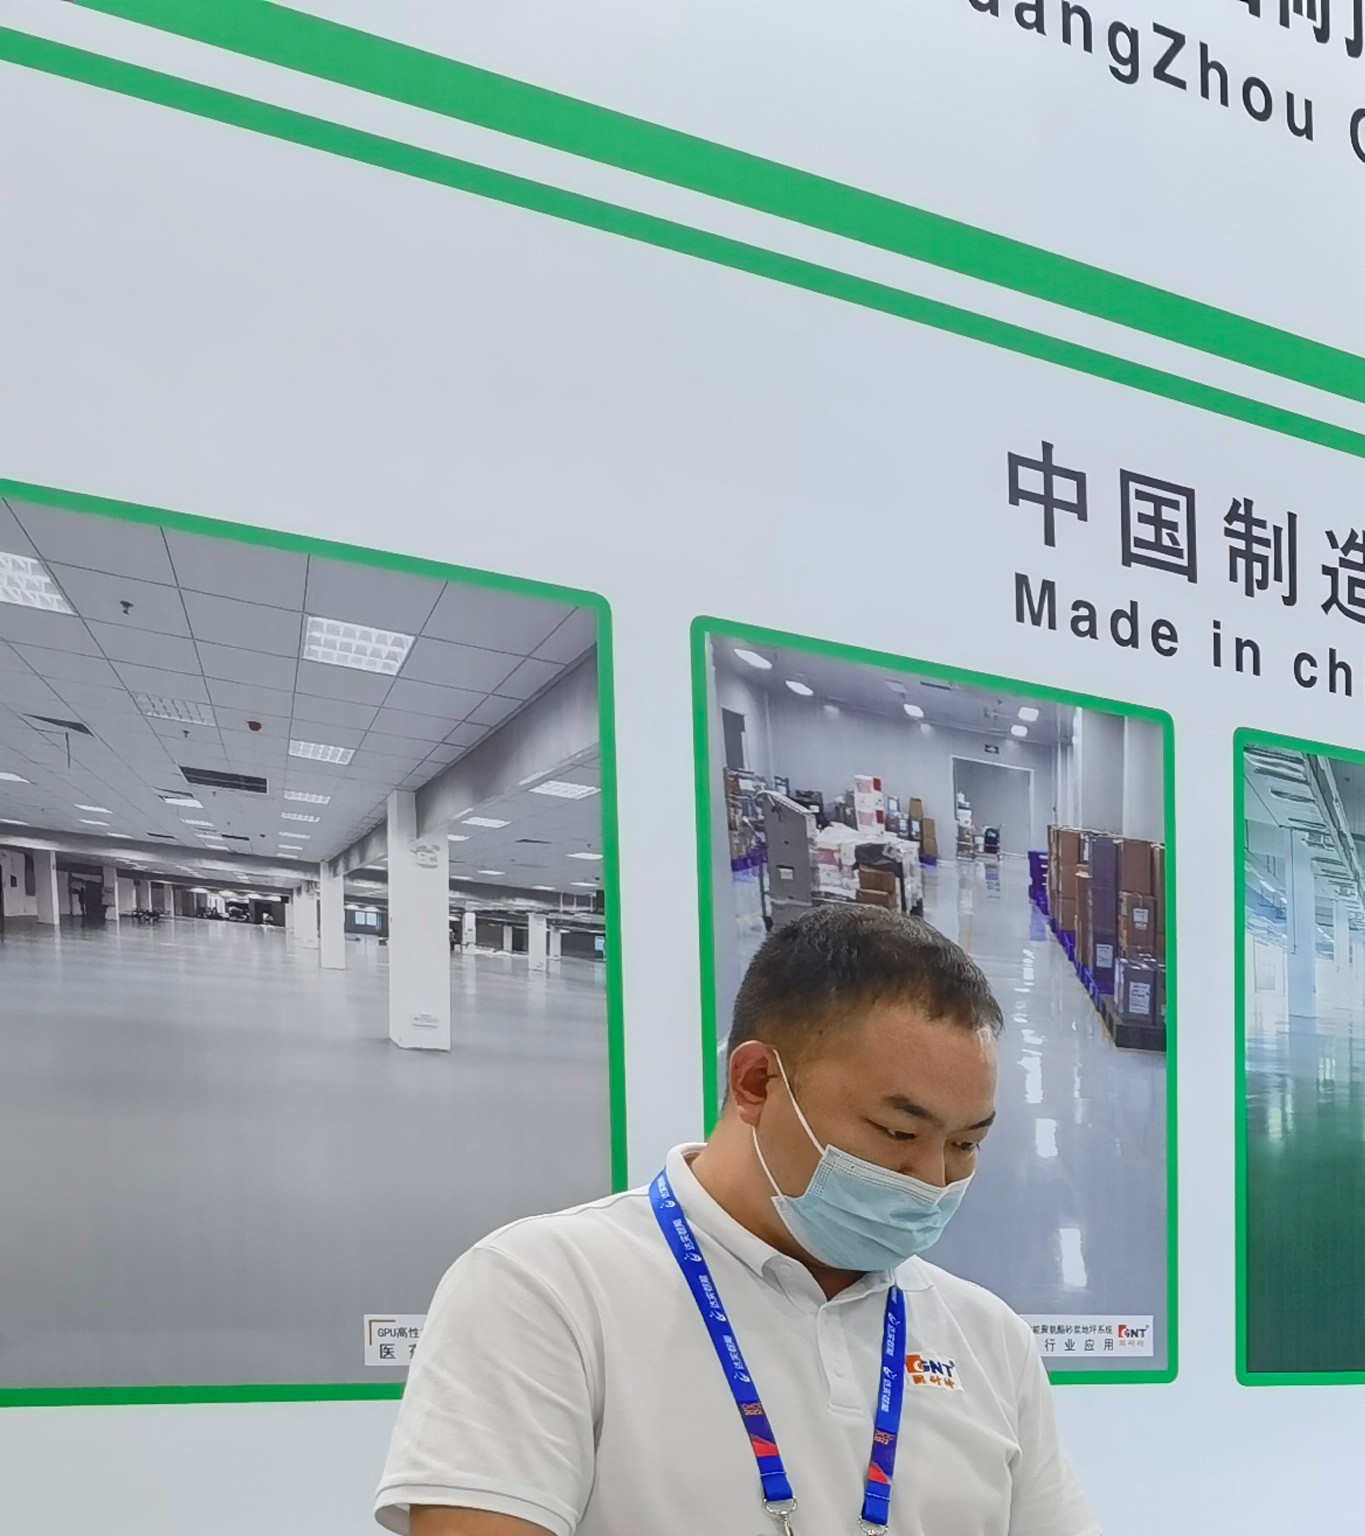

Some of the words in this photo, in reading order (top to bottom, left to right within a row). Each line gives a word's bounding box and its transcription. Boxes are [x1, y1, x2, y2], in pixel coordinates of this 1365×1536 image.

[968, 0, 1313, 141] angZhou
[1014, 572, 1180, 657] Made
[1212, 620, 1262, 677] in
[377, 1326, 424, 1338] GPU高性
[1119, 1325, 1147, 1339] GNT
[1044, 1338, 1114, 1352] 行业应用
